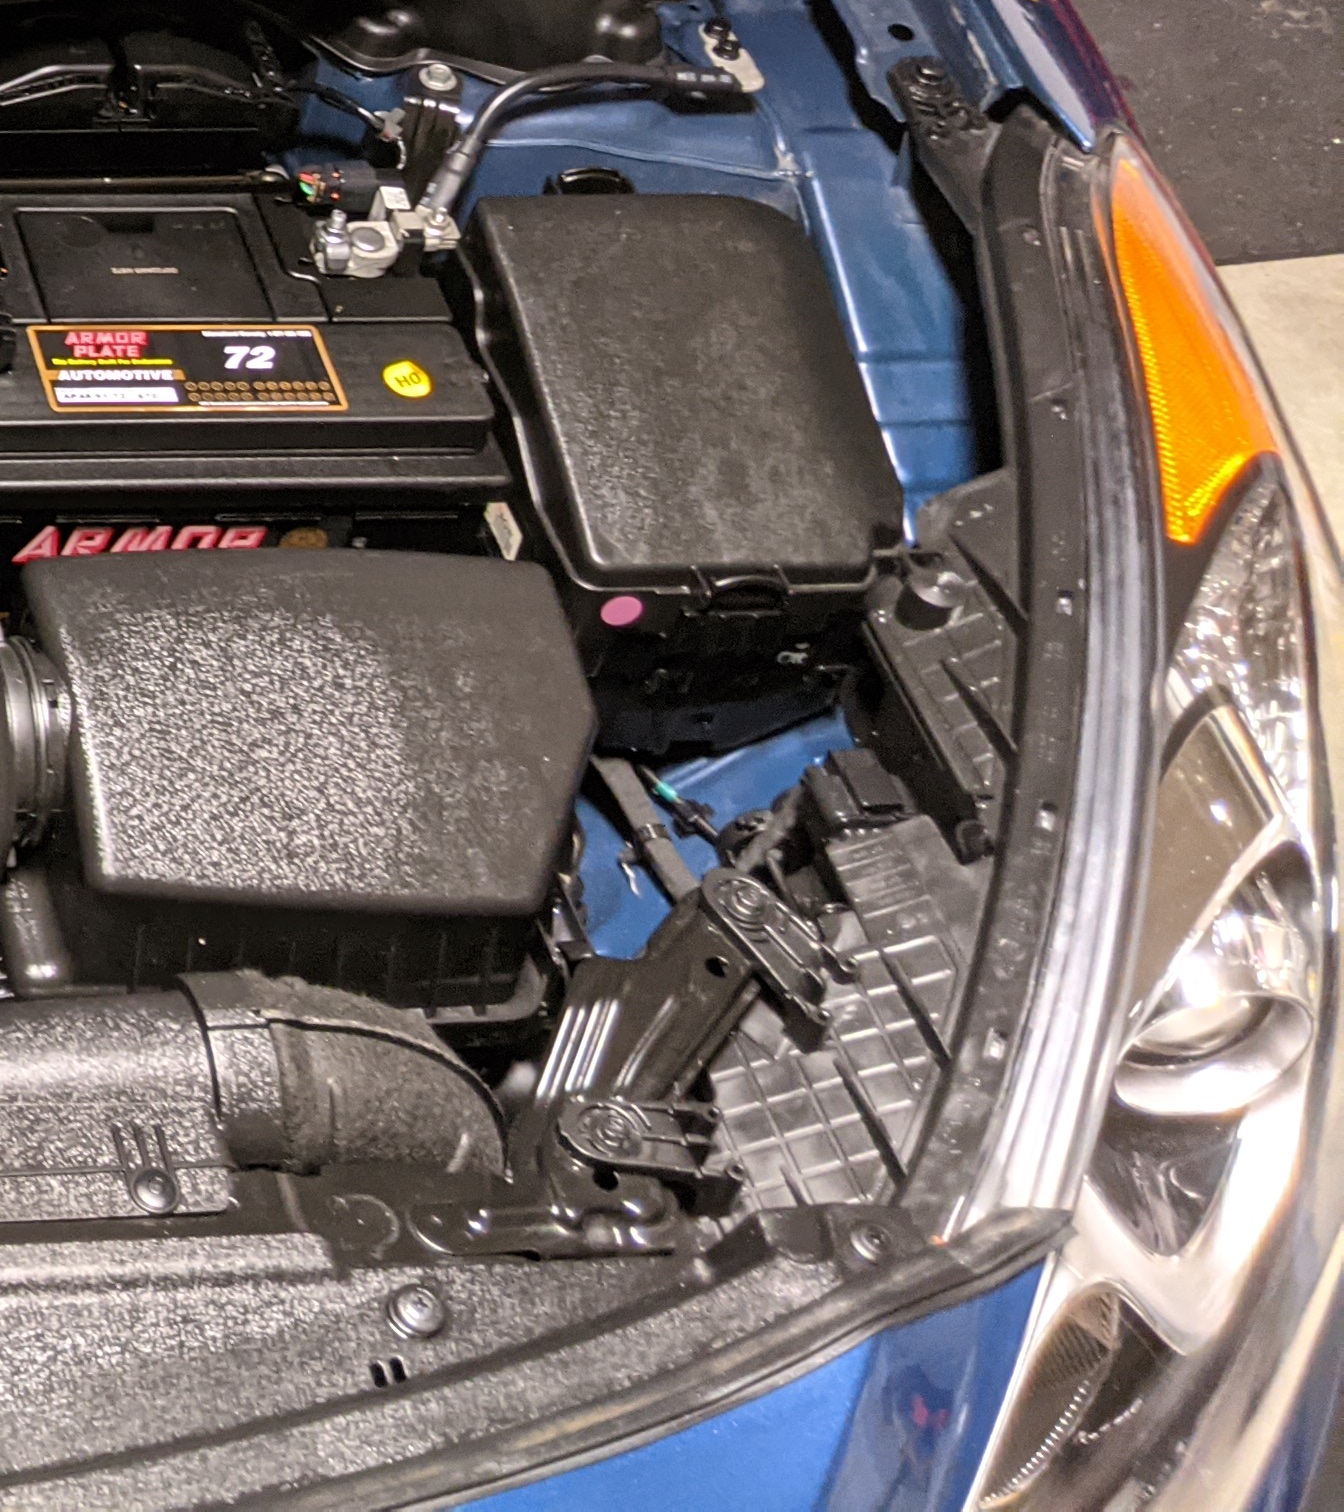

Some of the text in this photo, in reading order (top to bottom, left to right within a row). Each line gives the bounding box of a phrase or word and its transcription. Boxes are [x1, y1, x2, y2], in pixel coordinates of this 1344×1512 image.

[65, 331, 148, 345] ARMOR
[73, 345, 141, 358] PLATE
[223, 345, 277, 369] 72
[57, 369, 175, 381] AUTOMOTIVE
